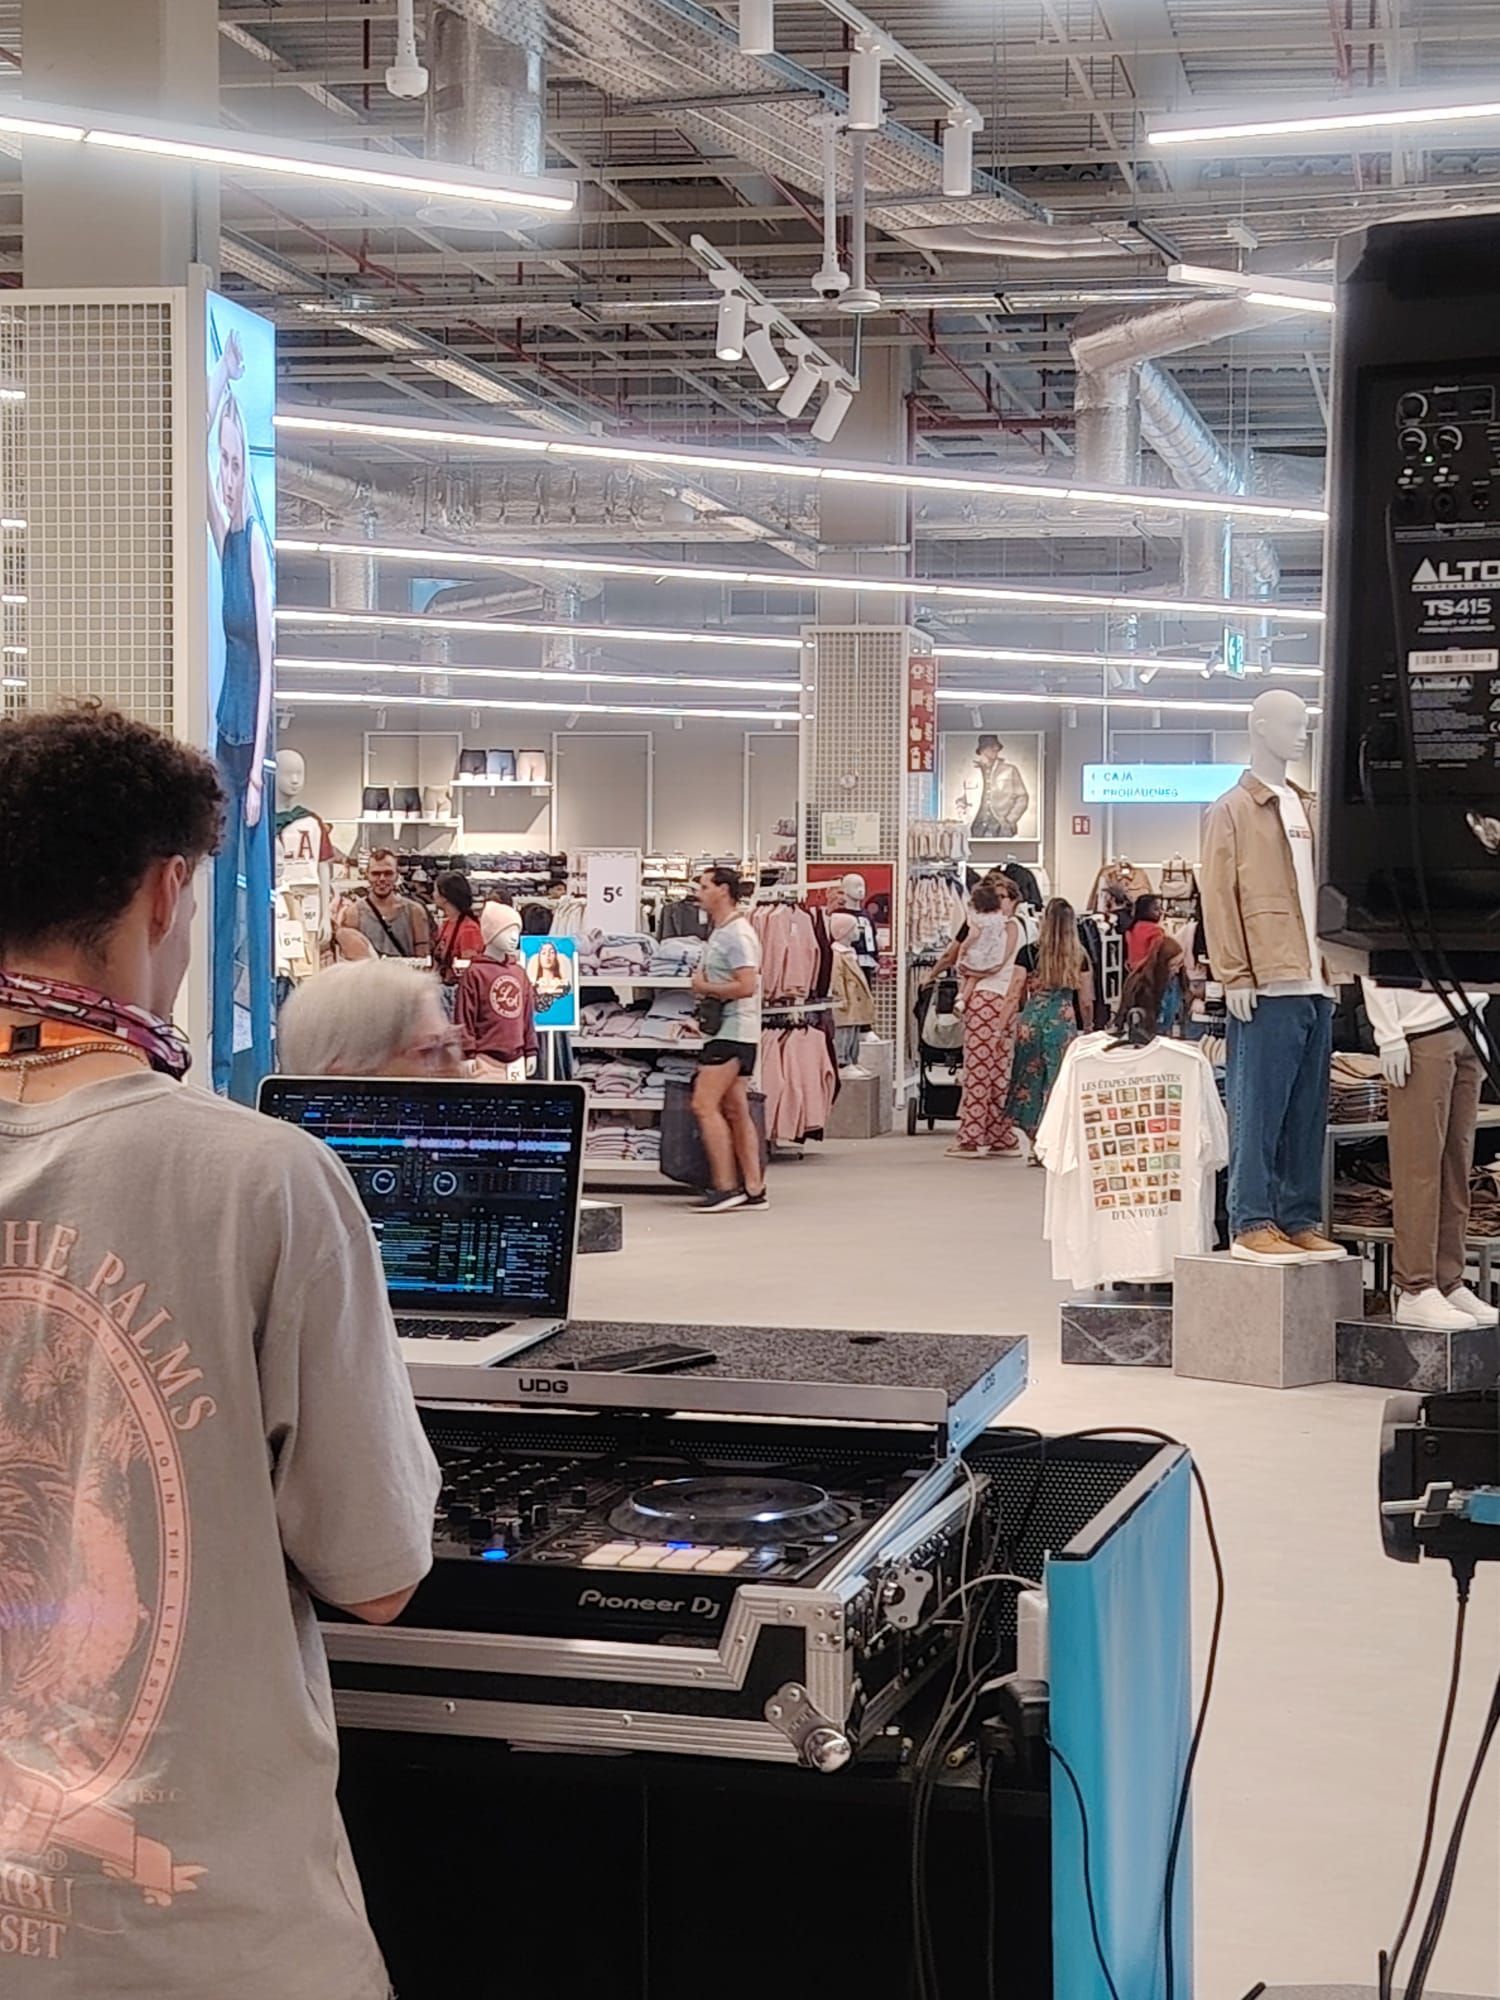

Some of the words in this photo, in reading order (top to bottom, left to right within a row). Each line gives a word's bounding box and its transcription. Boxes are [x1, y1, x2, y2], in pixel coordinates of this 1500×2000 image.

[1411, 557, 1500, 582] ALTO
[1422, 598, 1492, 616] TS415
[1103, 772, 1133, 782] CAJA
[1081, 1081, 1097, 1092] LES
[75, 1303, 142, 1390] MALIBU
[86, 1250, 217, 1430] PALMS
[518, 1378, 569, 1394] UDG
[155, 1440, 177, 1504] JOIN
[167, 1528, 179, 1578] THE
[578, 1589, 686, 1612] Pioneer
[122, 1604, 176, 1757] LIFESTYLE
